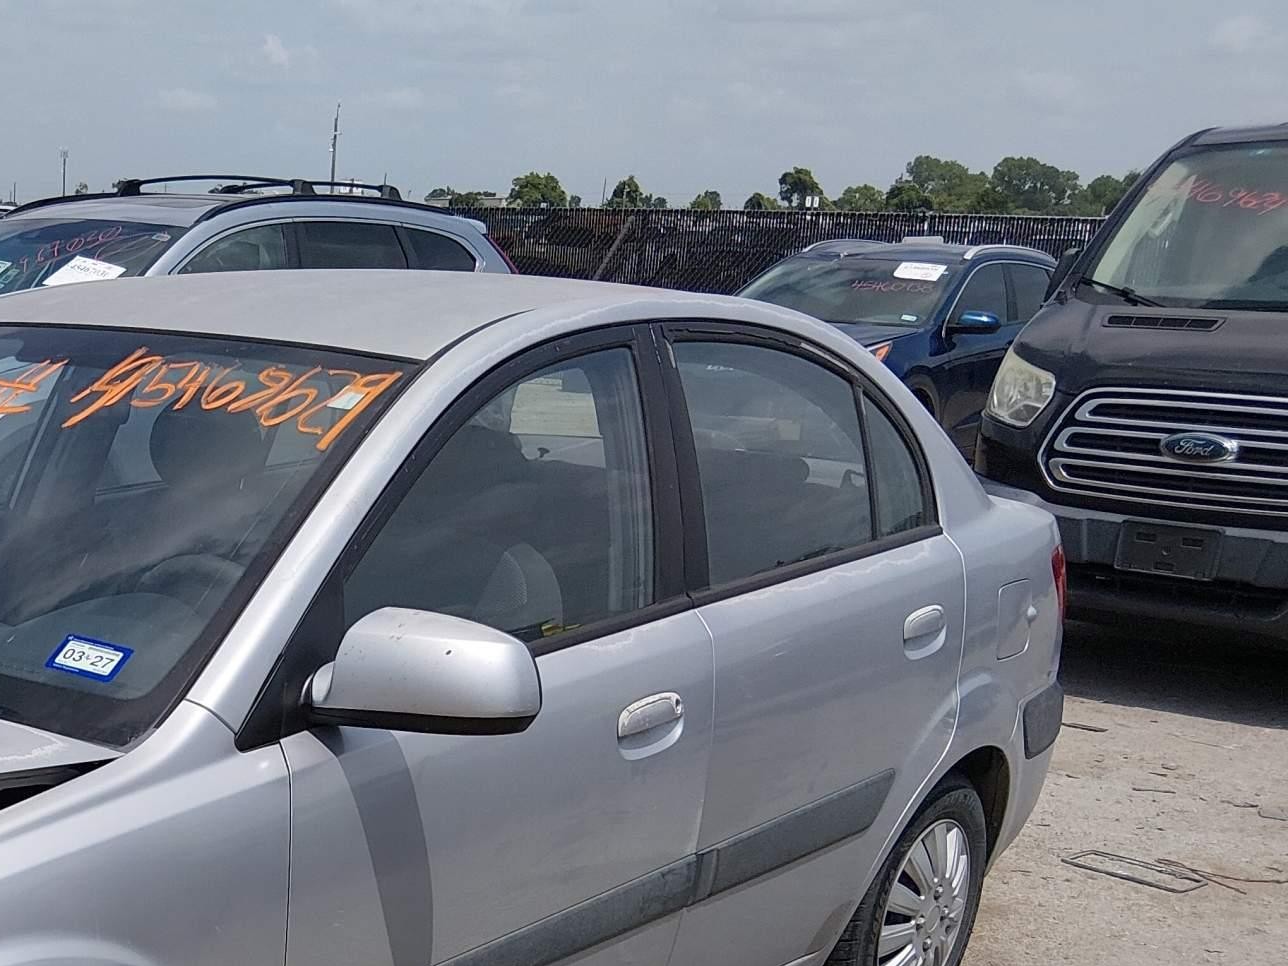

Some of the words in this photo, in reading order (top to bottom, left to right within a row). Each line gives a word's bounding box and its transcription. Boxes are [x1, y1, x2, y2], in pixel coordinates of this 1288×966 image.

[1174, 438, 1215, 456] Ford
[62, 648, 86, 662] 03
[89, 655, 115, 669] 27
